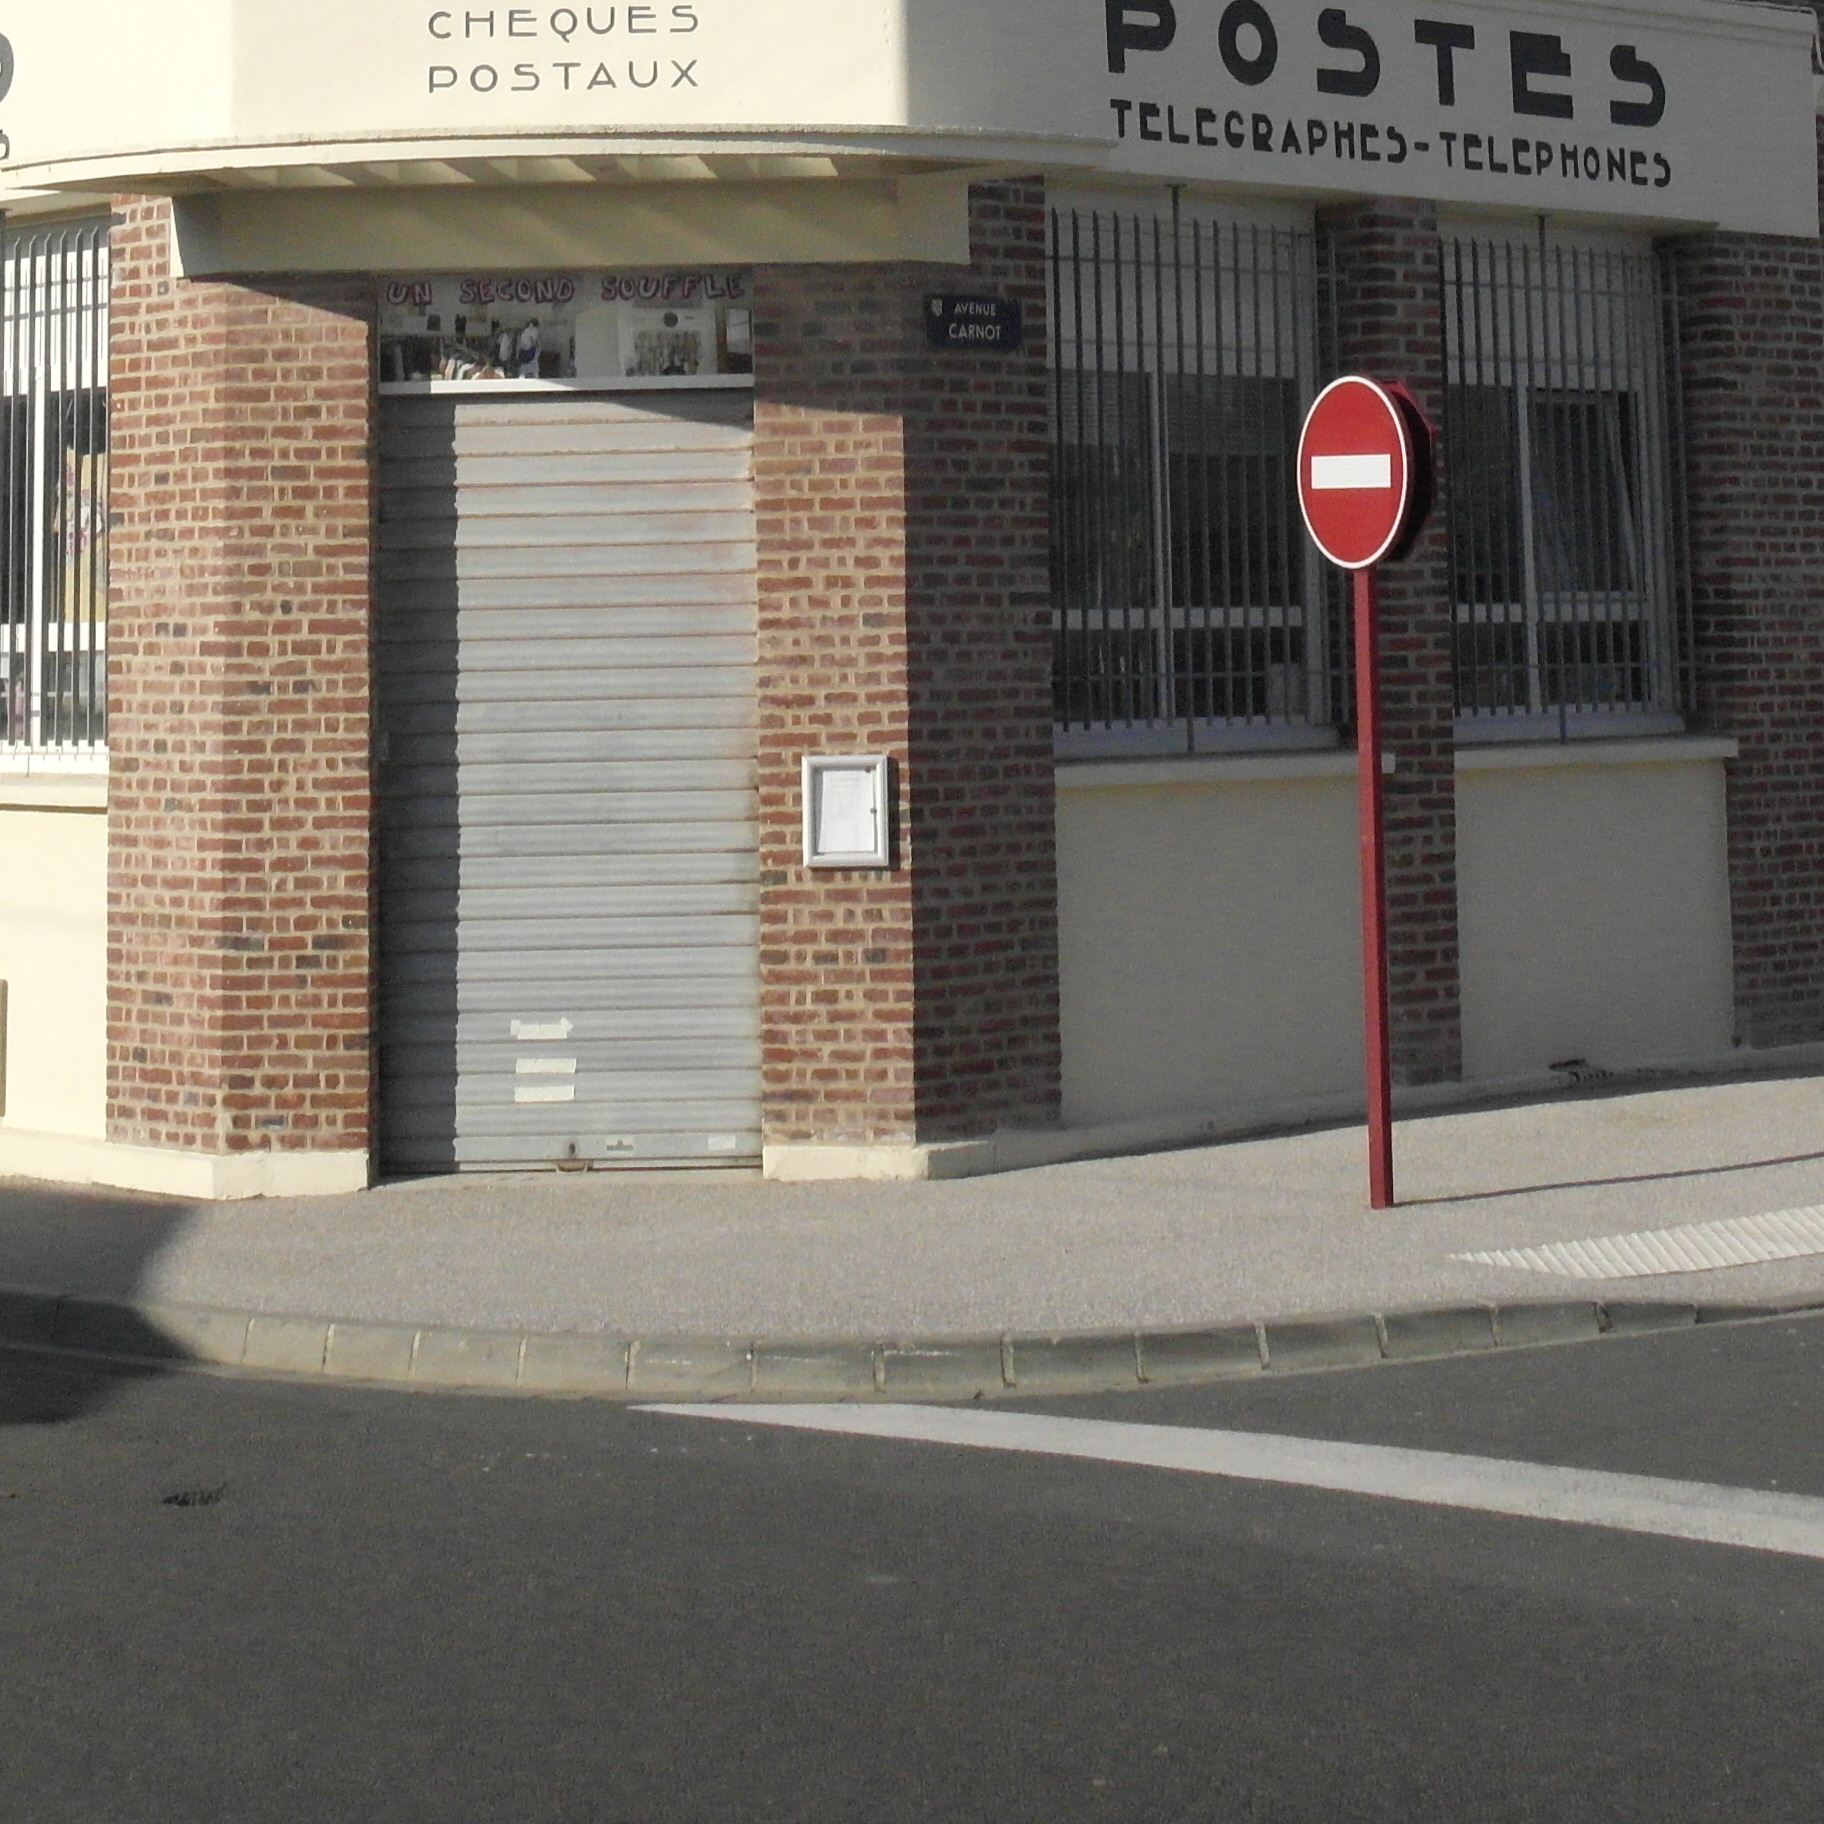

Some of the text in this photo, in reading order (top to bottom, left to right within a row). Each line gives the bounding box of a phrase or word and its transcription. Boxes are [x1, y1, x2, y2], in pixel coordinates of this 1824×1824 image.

[427, 4, 699, 43] CHEQUES
[428, 59, 699, 94] POSTAUX
[387, 274, 745, 305] UN SECOND SOUFFLE
[954, 302, 997, 316] AVENUE
[948, 323, 1002, 341] CARNOT
